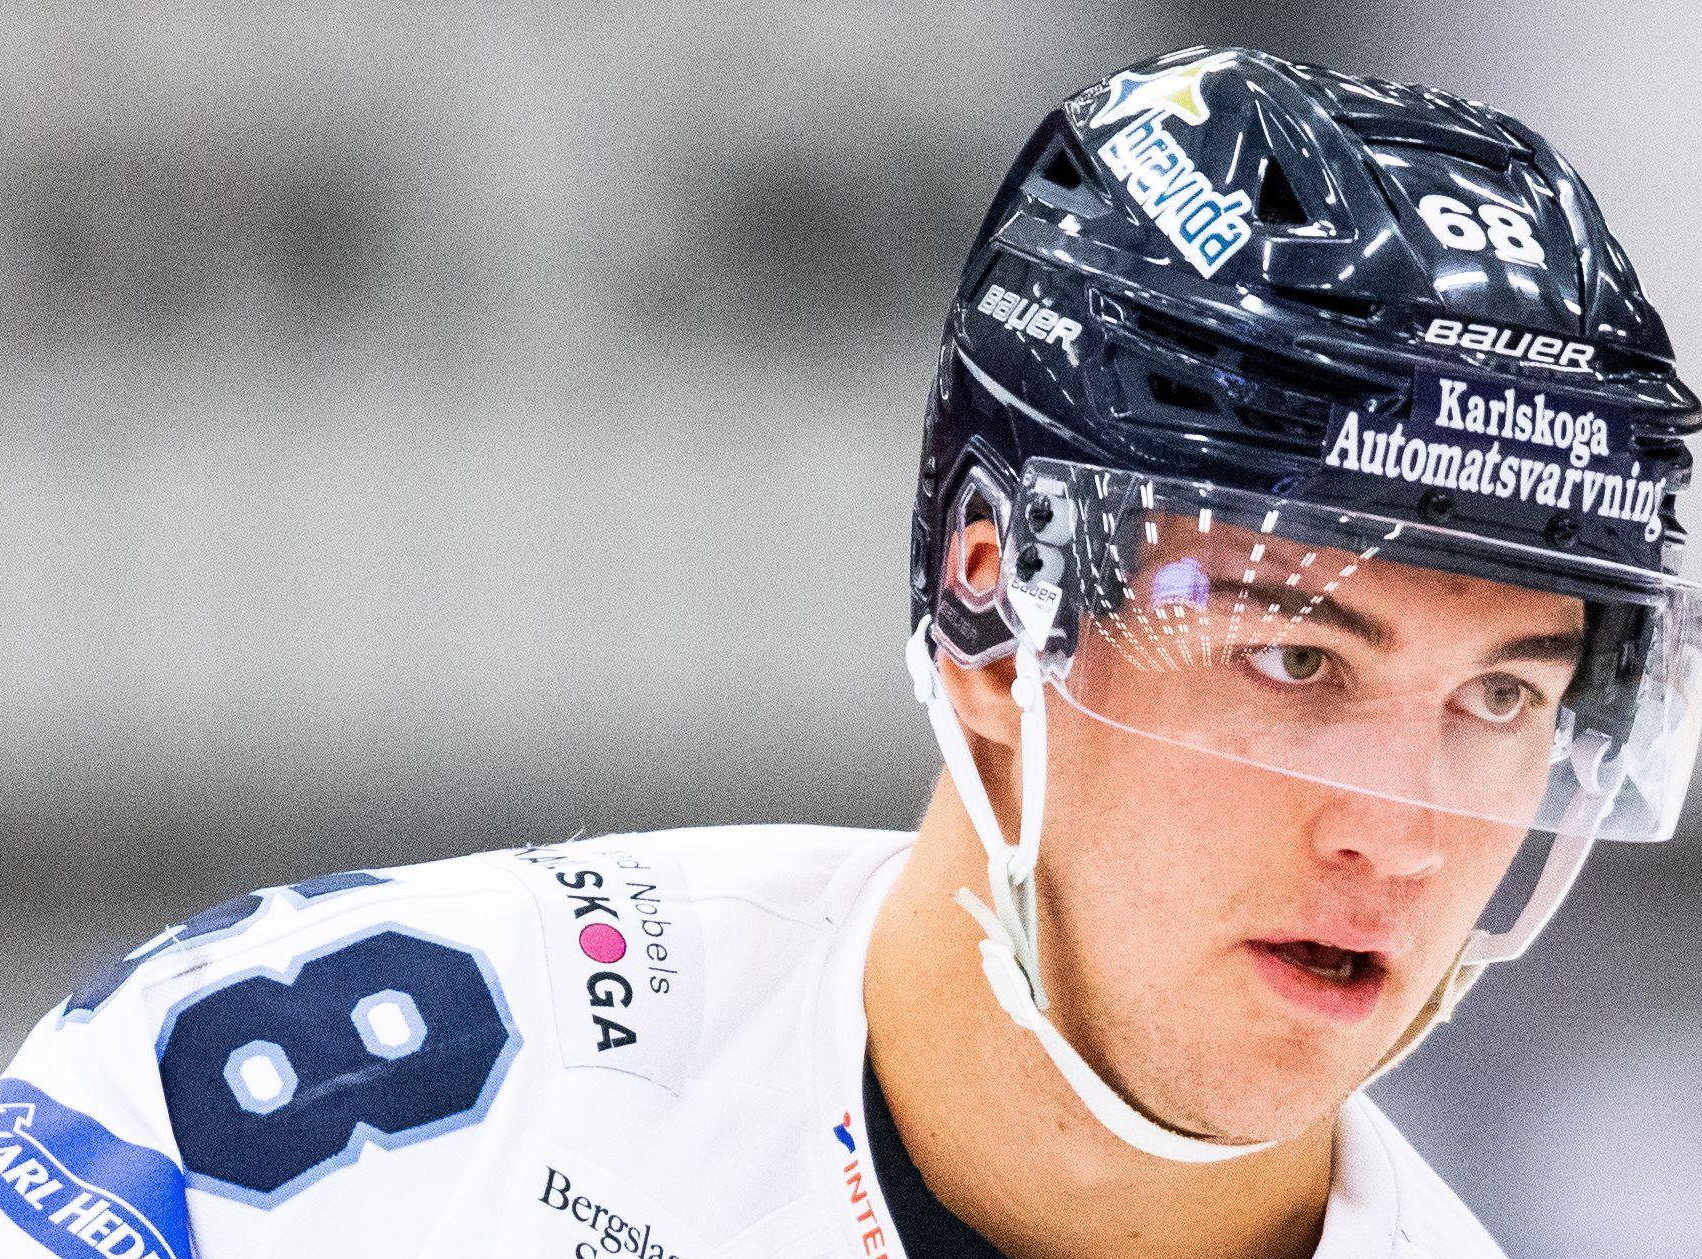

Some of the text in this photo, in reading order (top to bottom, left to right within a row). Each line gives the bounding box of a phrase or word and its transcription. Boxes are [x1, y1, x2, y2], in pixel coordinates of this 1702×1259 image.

[1109, 107, 1244, 268] bravida
[1419, 194, 1548, 270] 68
[1325, 411, 1667, 543] Automatsvarvning
[1435, 378, 1609, 467] Karlskoga
[515, 848, 638, 1054] SKOGA
[626, 882, 678, 995] Nobels
[51, 866, 525, 1212] 8
